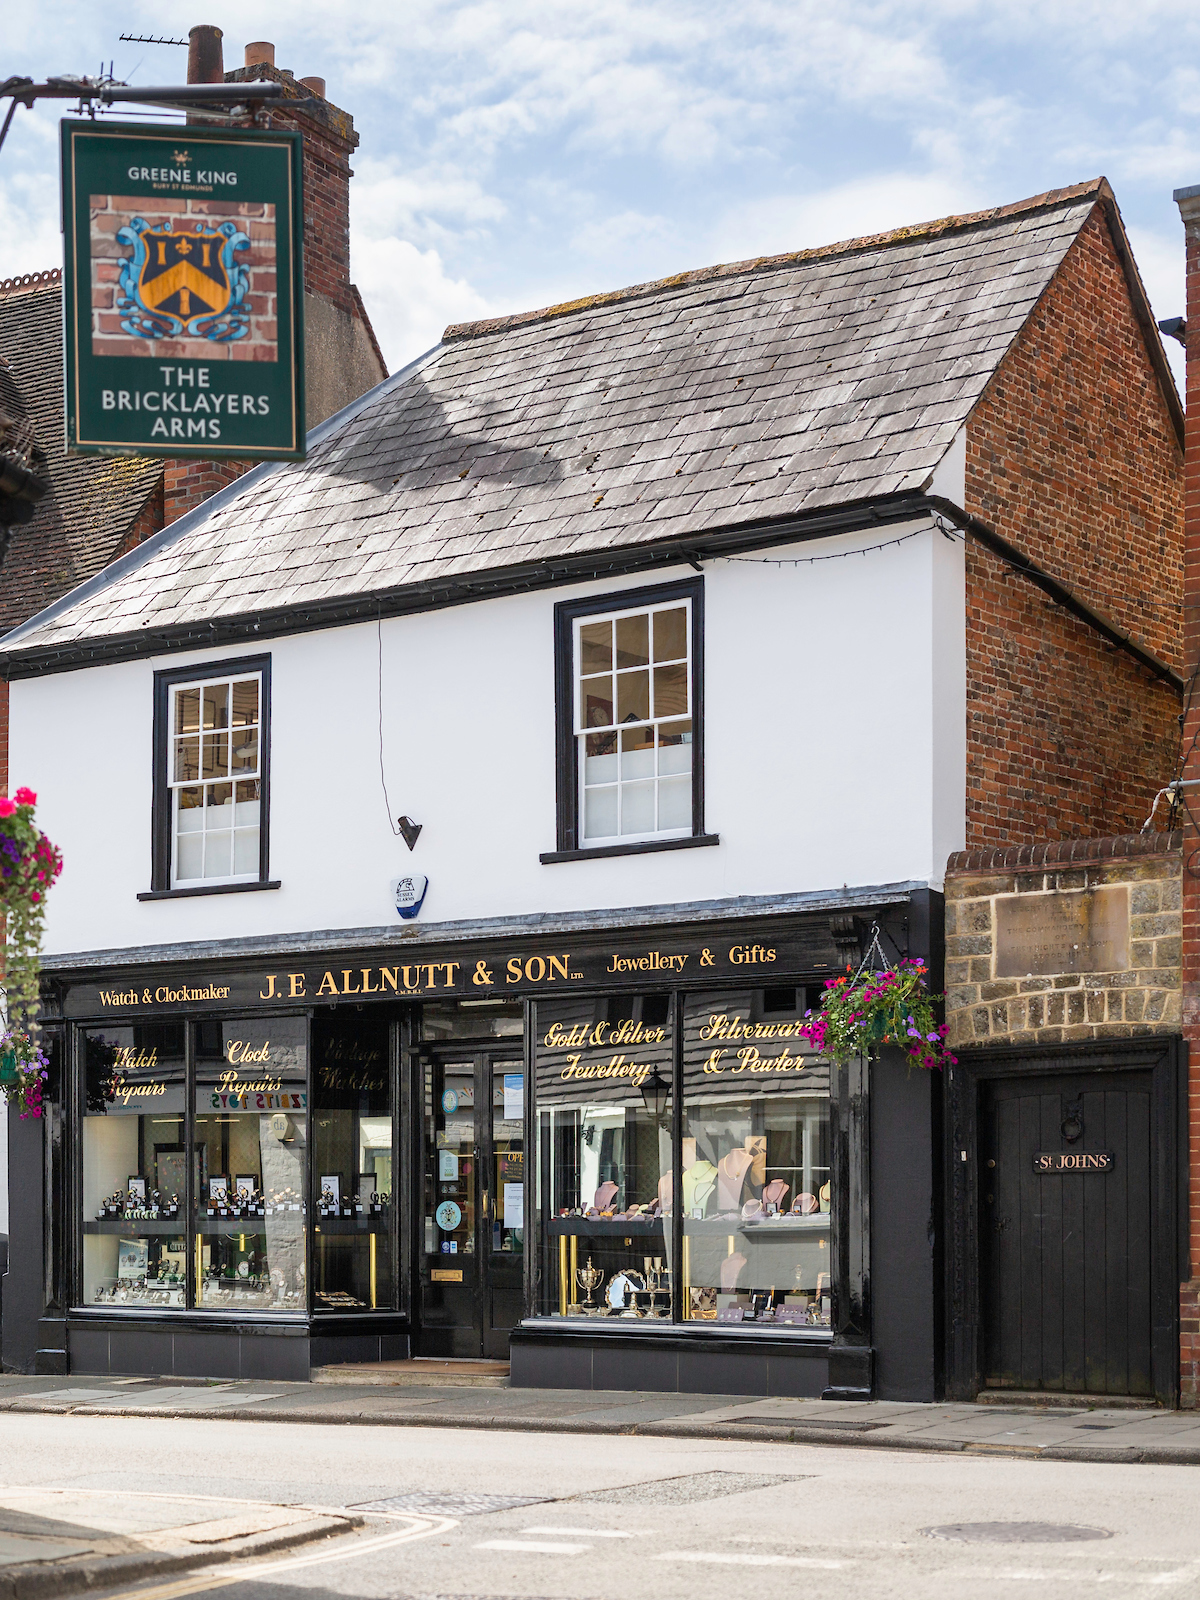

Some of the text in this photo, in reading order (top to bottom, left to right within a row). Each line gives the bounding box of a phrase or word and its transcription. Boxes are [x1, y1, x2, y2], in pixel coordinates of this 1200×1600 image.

[128, 167, 237, 185] GREENE KING
[153, 182, 170, 190] BURY
[181, 184, 213, 192] EDMUNDS
[160, 366, 210, 388] THE
[102, 390, 270, 415] BRICKLAYERS
[151, 417, 221, 439] ARMS
[607, 944, 777, 973] Jewellery & Gifts
[259, 975, 282, 1000] J.
[287, 973, 307, 998] E
[315, 962, 460, 996] ALLNUTT
[472, 960, 494, 986] &
[506, 954, 571, 984] SON
[99, 983, 231, 1007] Watch & Clockmaker
[544, 1019, 666, 1048] Gold & Silver
[113, 1047, 158, 1068] Watch
[227, 1040, 271, 1064] Clock
[703, 1046, 806, 1075] & Pewter
[318, 1066, 386, 1091] Watches
[560, 1054, 650, 1087] Jewellery
[102, 1075, 167, 1105] Repairs
[214, 1070, 283, 1101] Repairs
[1056, 1154, 1108, 1169] JOHNS
